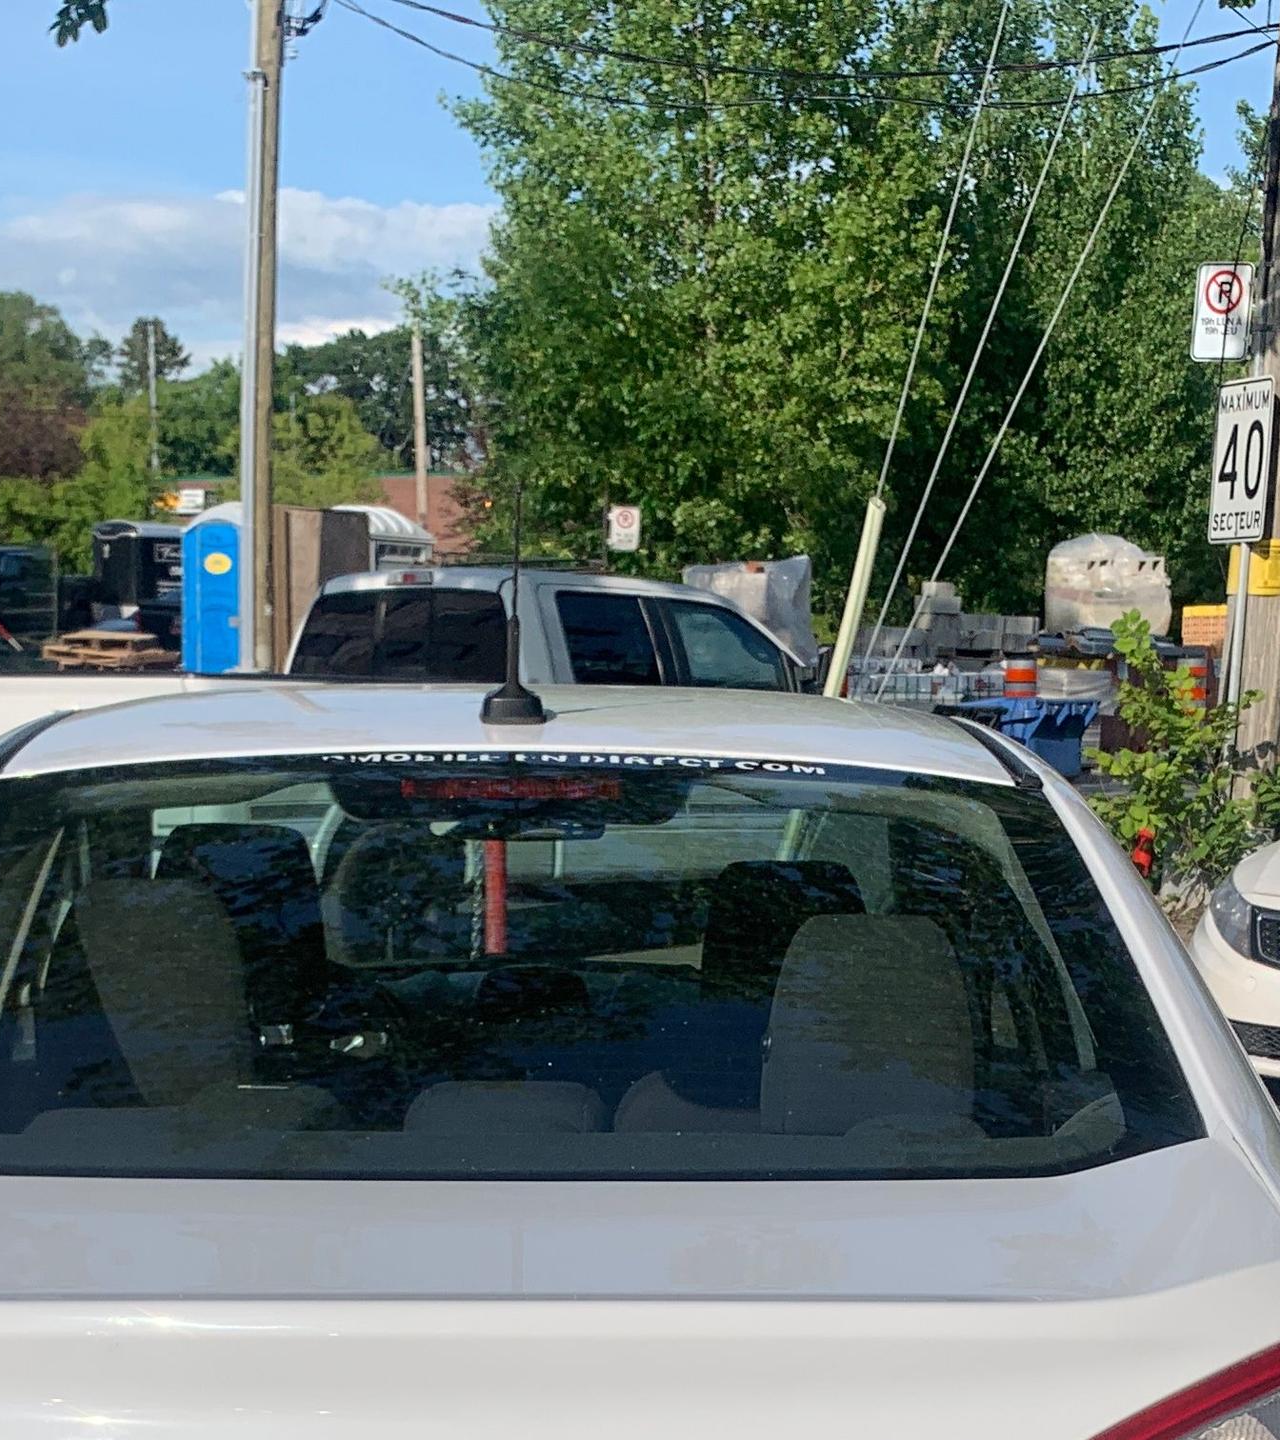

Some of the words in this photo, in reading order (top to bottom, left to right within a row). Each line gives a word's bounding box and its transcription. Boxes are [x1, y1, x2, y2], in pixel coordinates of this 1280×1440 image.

[1220, 389, 1270, 414] MAXIMUM
[1218, 419, 1264, 500] 40
[1212, 510, 1261, 533] SECTEUR
